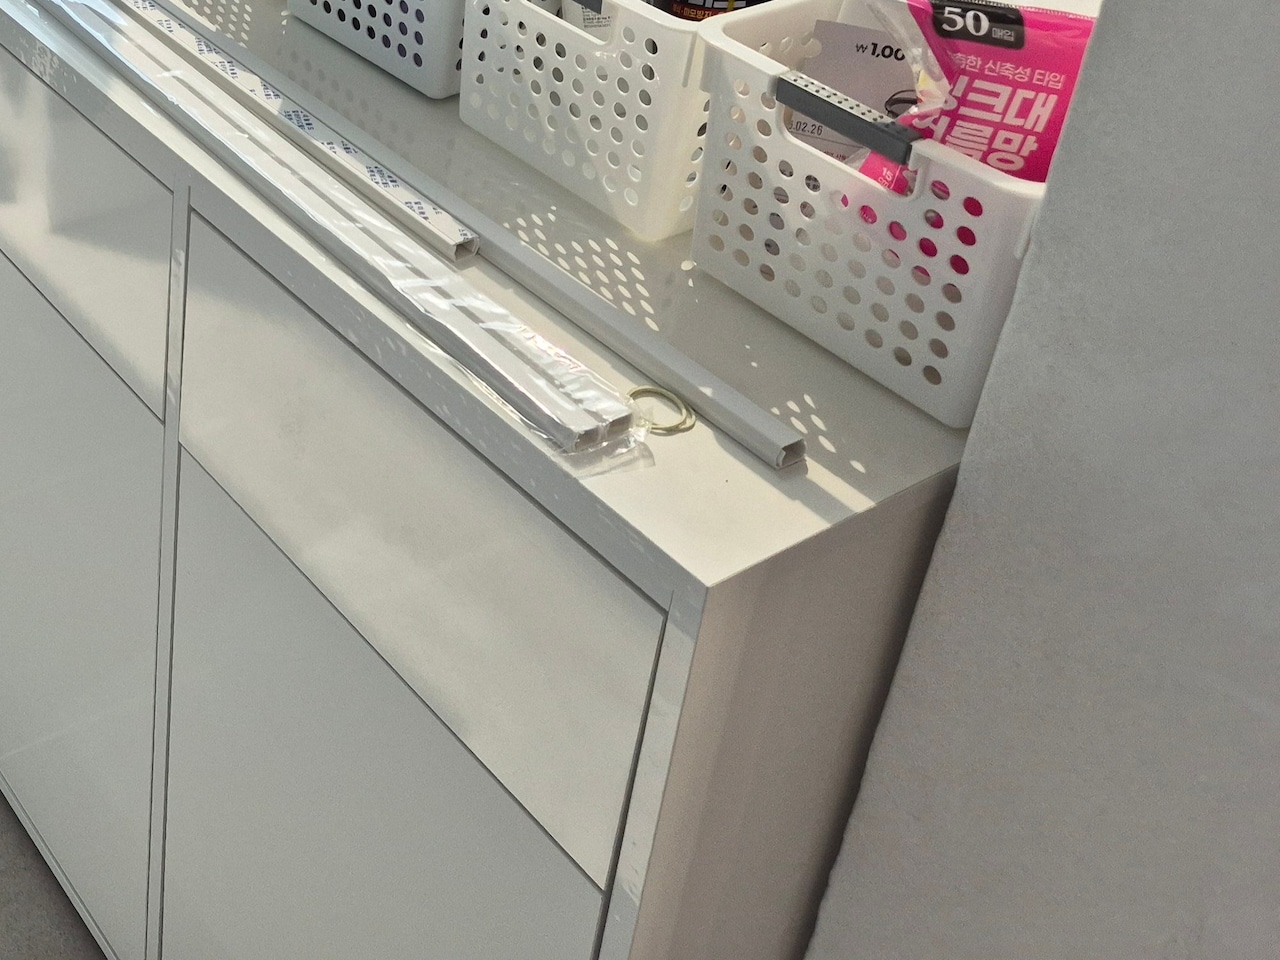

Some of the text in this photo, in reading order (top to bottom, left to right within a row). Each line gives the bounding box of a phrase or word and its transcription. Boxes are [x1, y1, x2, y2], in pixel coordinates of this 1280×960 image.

[984, 59, 1031, 83] 신축성
[1032, 69, 1065, 90] 타입
[881, 167, 894, 181] 15
